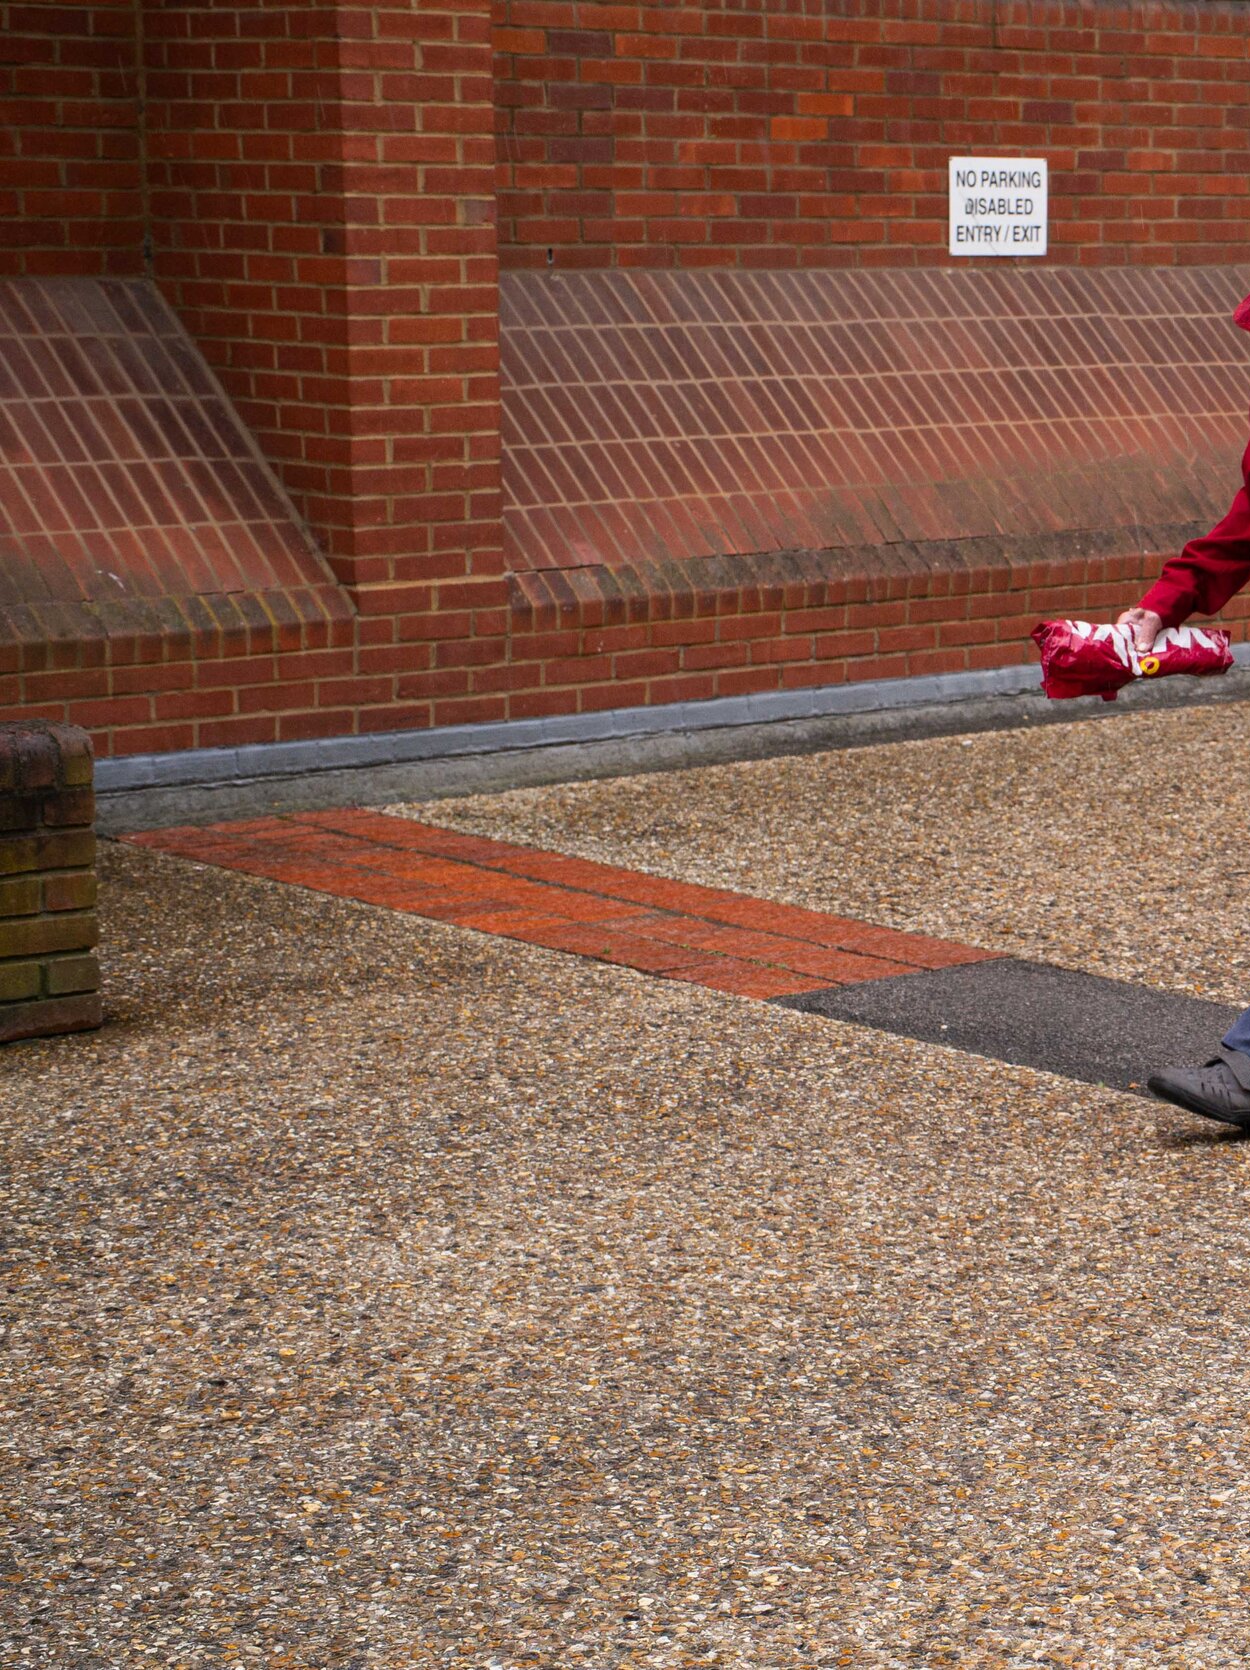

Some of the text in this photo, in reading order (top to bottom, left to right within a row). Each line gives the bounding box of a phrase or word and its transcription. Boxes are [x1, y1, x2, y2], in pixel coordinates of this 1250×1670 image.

[956, 170, 1041, 188] NO PARKING
[965, 198, 1034, 215] DISABLED
[956, 225, 1001, 242] ENTRY
[1013, 225, 1041, 242] EXIT
